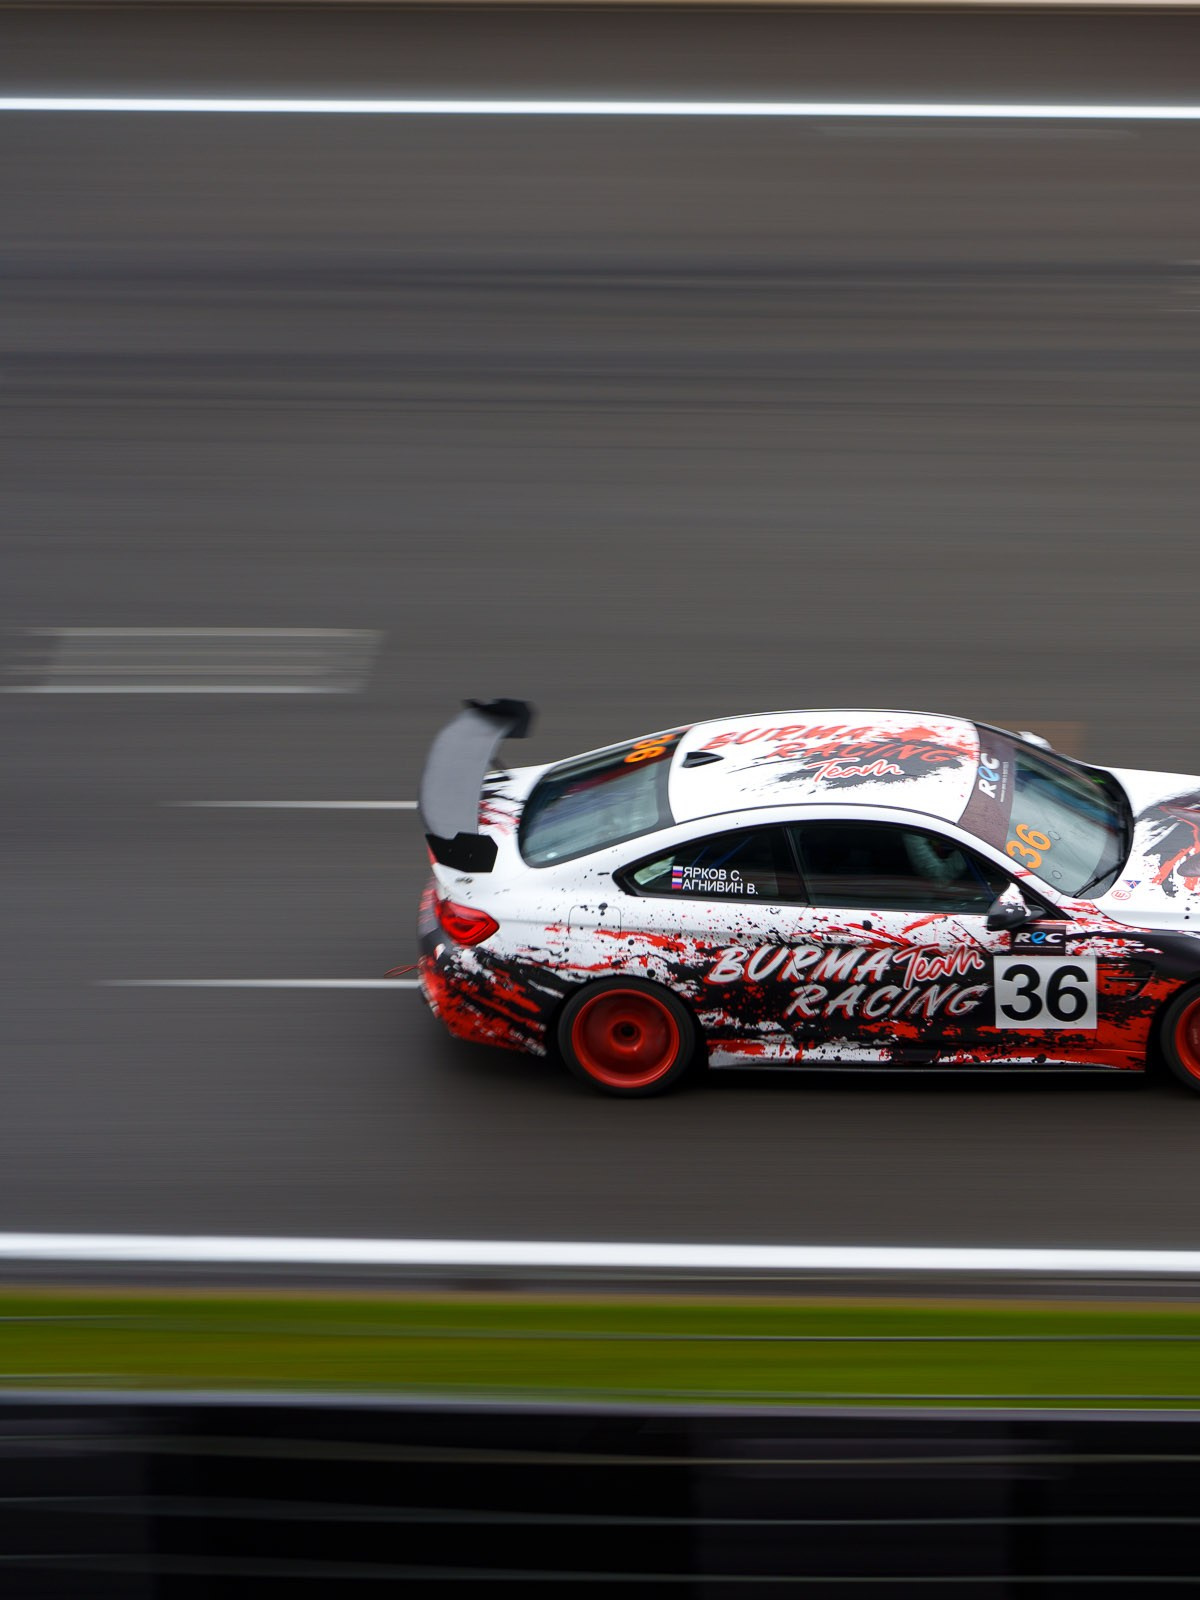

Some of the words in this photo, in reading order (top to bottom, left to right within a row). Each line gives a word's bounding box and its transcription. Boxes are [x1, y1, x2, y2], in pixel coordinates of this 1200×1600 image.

[699, 724, 873, 751] BURMA
[764, 740, 959, 762] RACING
[806, 757, 904, 783] Team
[1005, 823, 1051, 869] 36
[682, 878, 744, 894] АГНИВИН
[683, 866, 727, 881] ЯРКОВ
[703, 942, 890, 984] BURMA
[893, 942, 984, 991] Team
[783, 984, 991, 1020] RACING
[1000, 964, 1089, 1022] 36
